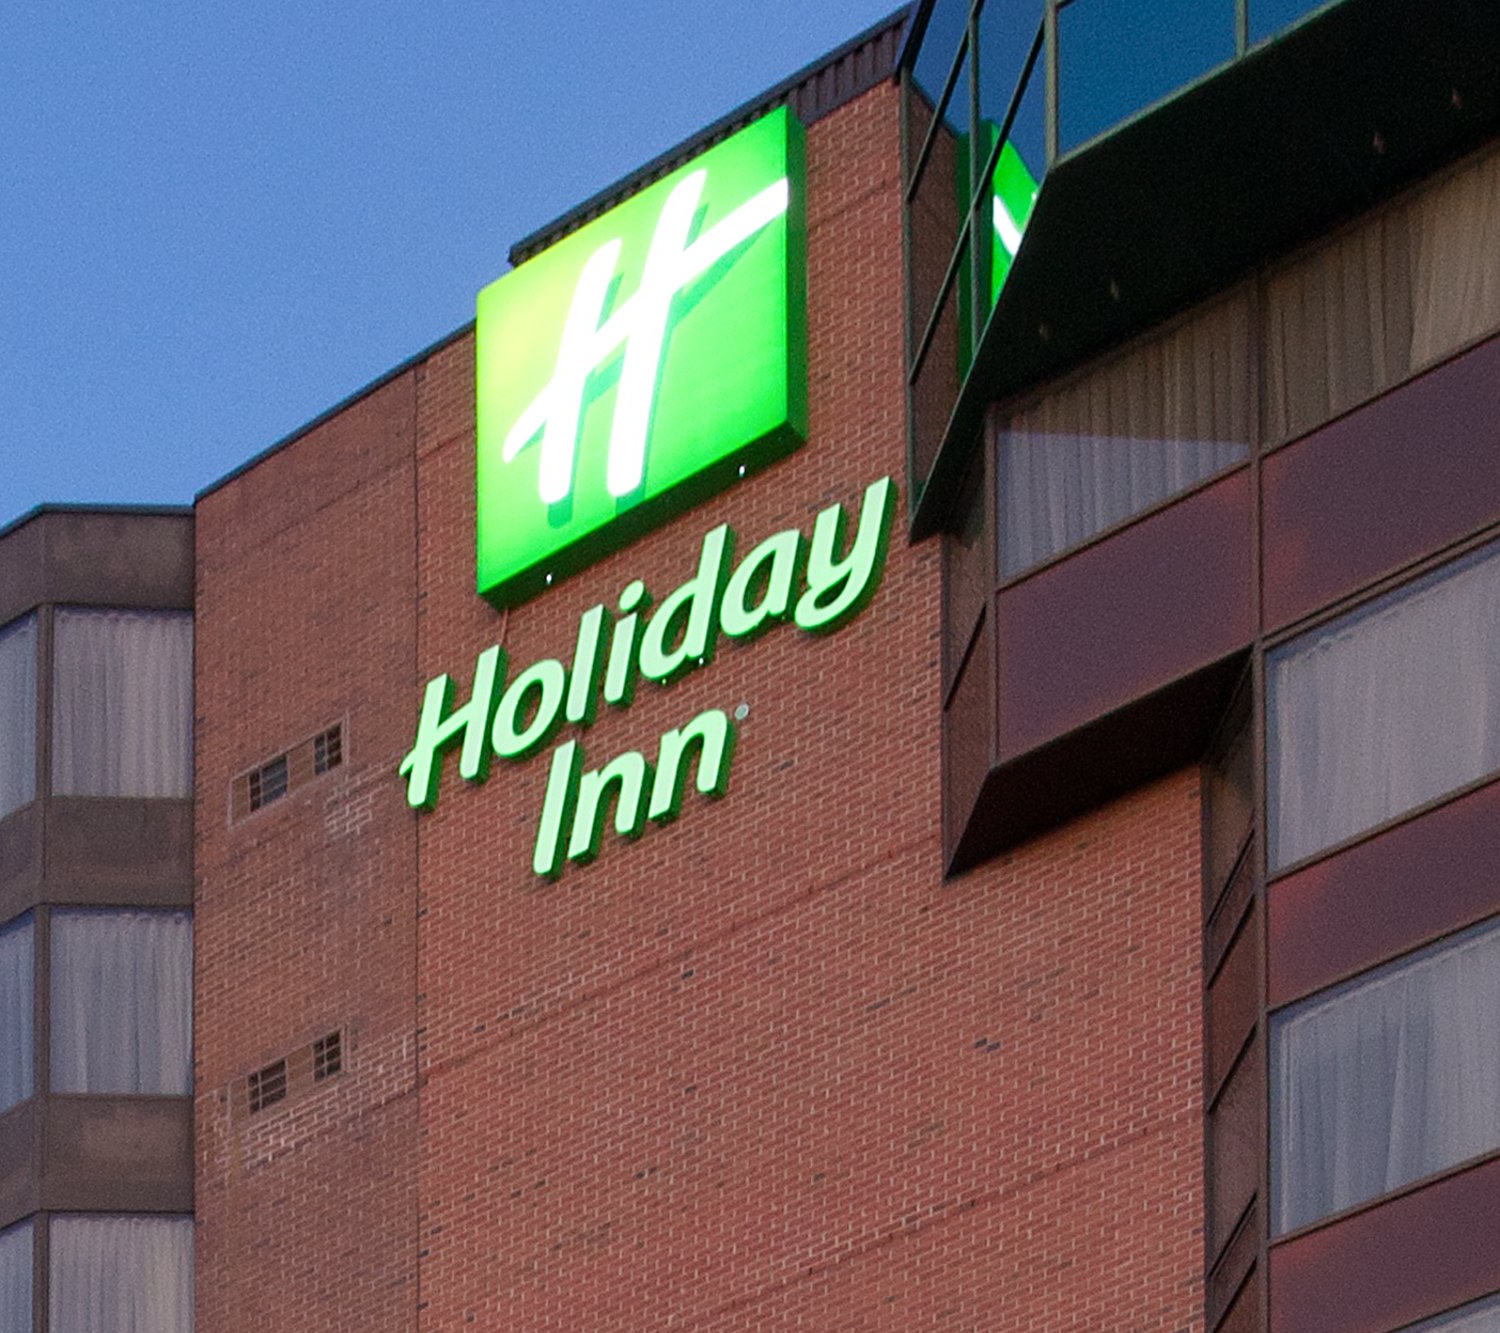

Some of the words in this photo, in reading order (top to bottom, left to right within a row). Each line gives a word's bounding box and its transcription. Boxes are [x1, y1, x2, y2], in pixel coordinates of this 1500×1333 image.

[502, 167, 790, 504] H
[399, 475, 896, 810] Holiday
[532, 708, 732, 878] Inn
